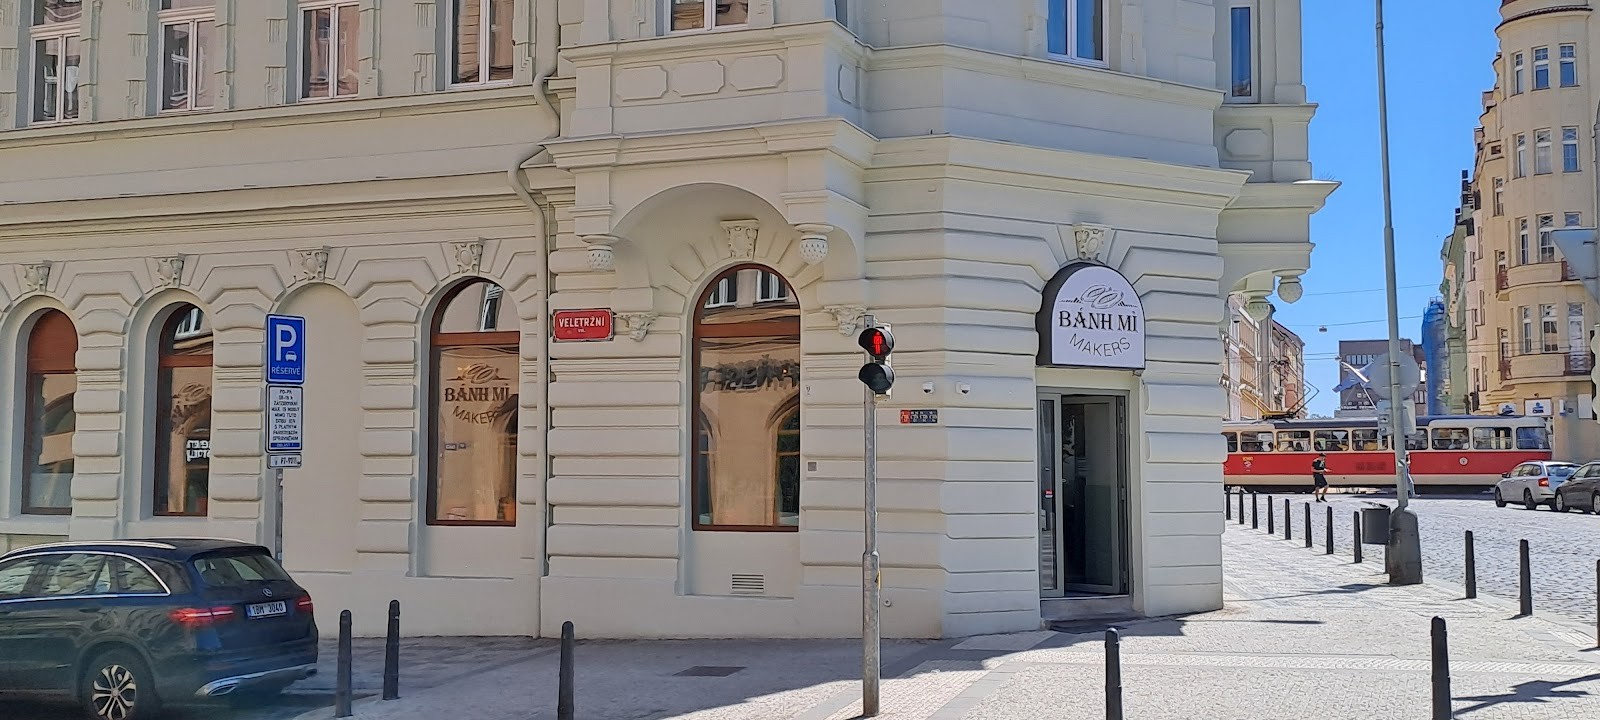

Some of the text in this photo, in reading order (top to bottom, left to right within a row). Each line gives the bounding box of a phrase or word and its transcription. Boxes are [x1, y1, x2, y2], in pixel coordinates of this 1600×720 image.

[559, 316, 605, 328] VELETRŽNÍ
[1059, 307, 1114, 331] BÁNH
[276, 324, 297, 361] P
[1069, 333, 1131, 357] MAKERS
[445, 384, 489, 401] BÁNH
